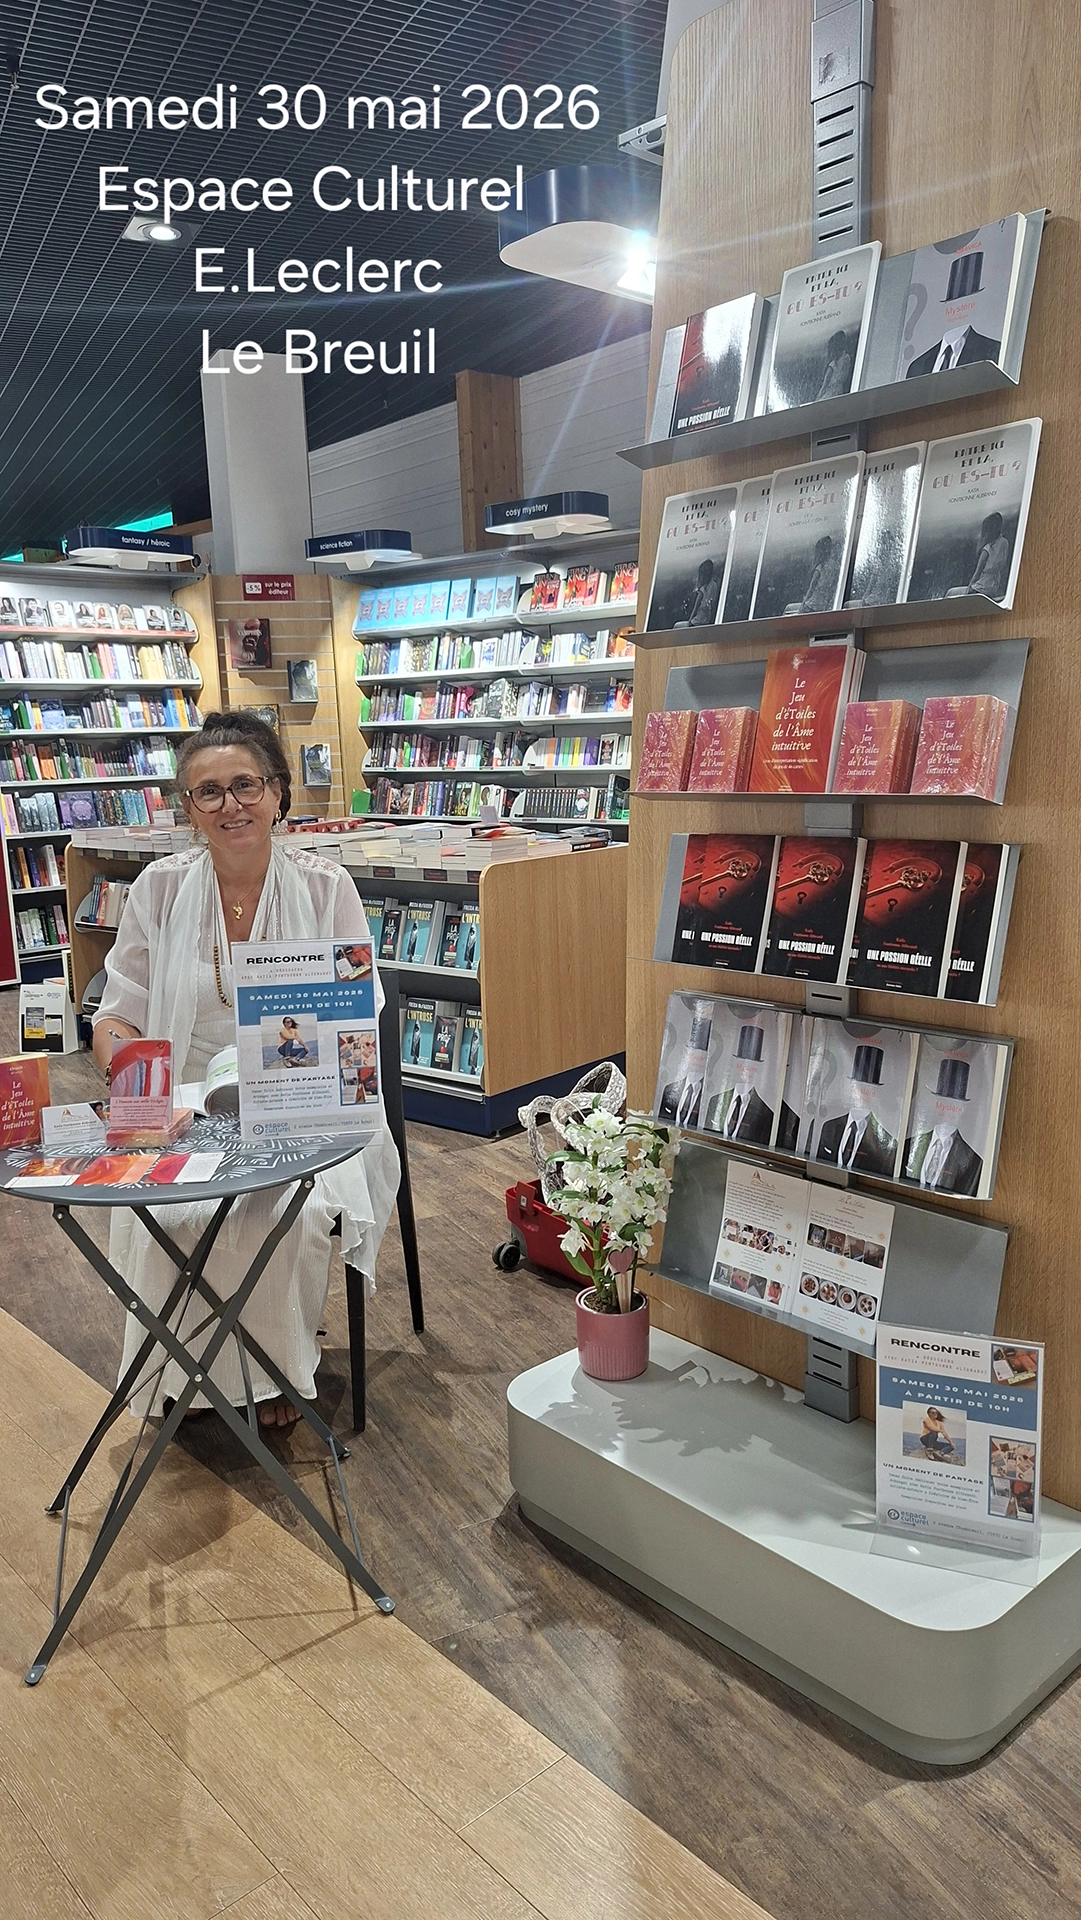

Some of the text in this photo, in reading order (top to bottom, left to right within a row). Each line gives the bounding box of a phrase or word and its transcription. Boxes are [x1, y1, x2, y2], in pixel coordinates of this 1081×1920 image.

[944, 301, 977, 318] Mystère
[954, 443, 988, 459] ENTRE
[960, 462, 1010, 485] ES-TU
[505, 503, 549, 517] cosy mystery
[121, 536, 146, 546] fantasy
[150, 538, 171, 548] héroic
[319, 540, 353, 551] science fiction
[567, 573, 586, 583] KING
[794, 678, 806, 689] Le
[789, 691, 806, 705] Jeu
[773, 722, 815, 738] de l'Âme
[864, 724, 873, 732] Le
[860, 734, 873, 744] Jeu
[771, 740, 812, 752] intuitive
[388, 918, 395, 927] LA
[461, 912, 480, 924] L'INTR
[450, 924, 457, 933] LA
[711, 932, 736, 944] PASSION
[778, 939, 791, 951] UNE
[790, 940, 816, 953] PASSION
[246, 954, 325, 965] RENCONTRE
[866, 949, 933, 967] UNE PASSION RÉELLE
[952, 957, 975, 973] RÉELLE
[249, 993, 292, 1001] SAMEDI
[337, 989, 364, 997] 2026
[273, 1003, 313, 1011] PARTIR
[464, 1017, 483, 1029] L'INTR
[441, 1025, 448, 1034] LA
[12, 1081, 21, 1089] Le
[11, 1090, 23, 1099] Jeu
[2, 1108, 35, 1121] de l'Âme
[3, 1119, 35, 1131] intuitive
[264, 1121, 289, 1129] espace
[264, 1125, 291, 1134] culturel
[890, 1337, 981, 1359] RENCONTRE
[891, 1376, 1025, 1404] SAMEDI 30 MAI 2026
[917, 1392, 963, 1405] PARTIR
[967, 1400, 984, 1409] DE
[987, 1403, 1011, 1414] 10H
[882, 1462, 895, 1470] UN
[895, 1464, 932, 1477] MOMENT
[945, 1474, 985, 1486] PARTAGE
[900, 1510, 927, 1521] espace
[900, 1515, 930, 1527] culturel
